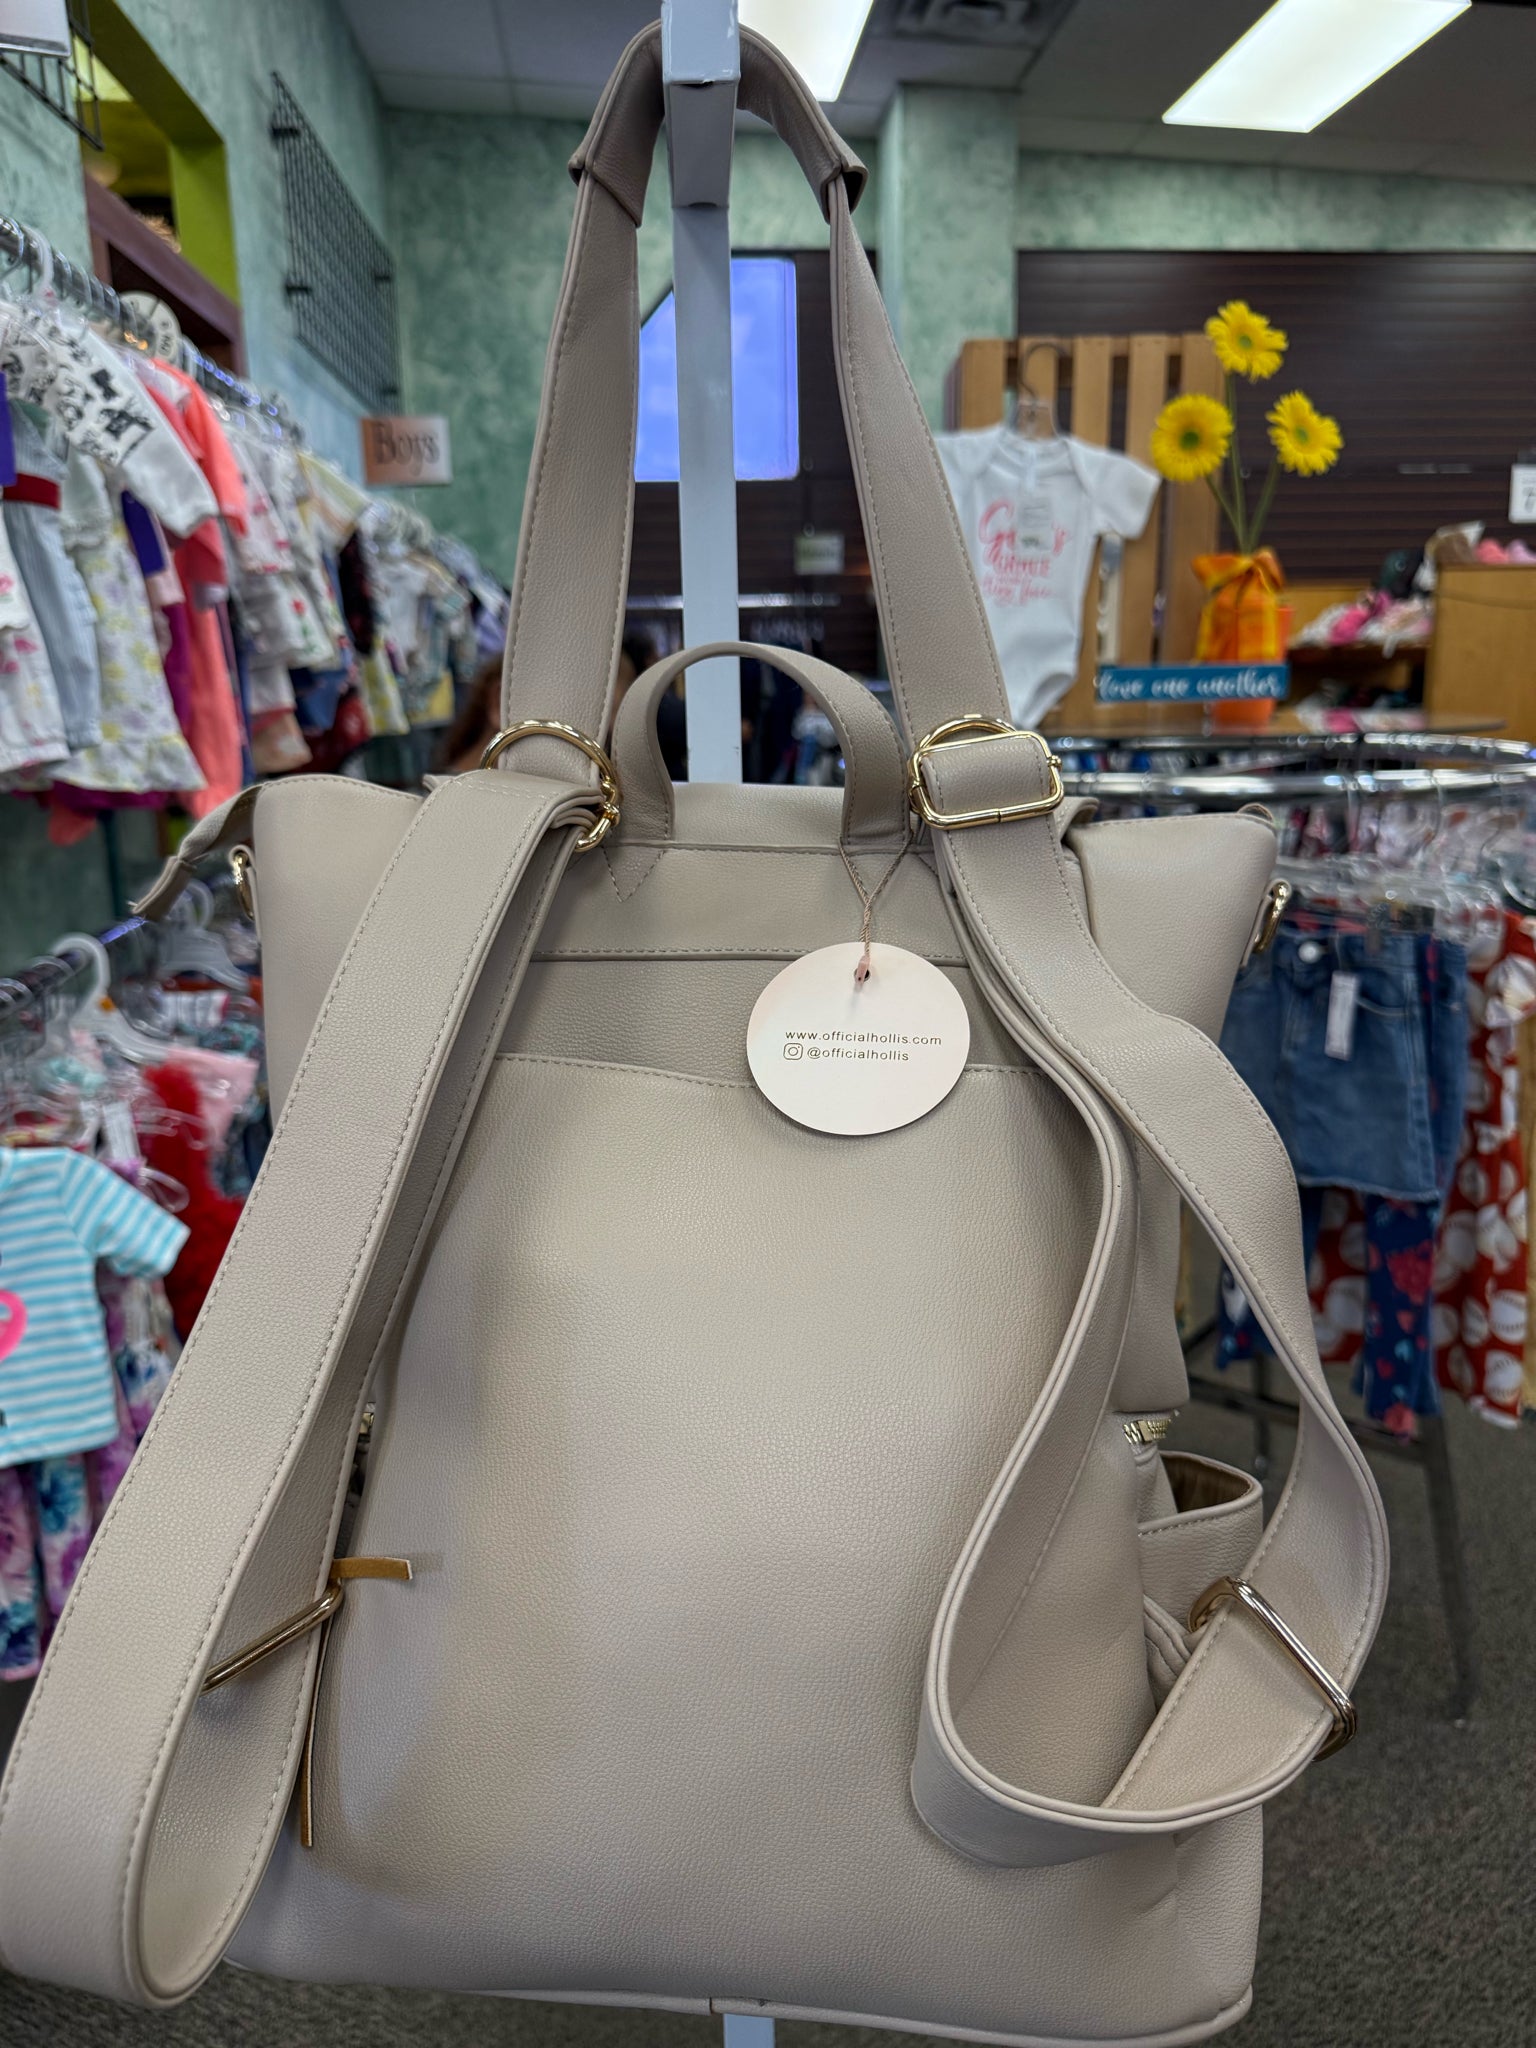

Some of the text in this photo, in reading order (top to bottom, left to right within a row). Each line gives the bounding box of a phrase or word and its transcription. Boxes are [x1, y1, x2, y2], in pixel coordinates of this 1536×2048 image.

[374, 421, 439, 477] Boys
[1151, 677, 1190, 699] one
[785, 1031, 942, 1046] www.officialhollis.com
[807, 1047, 909, 1061] @officialhollis
